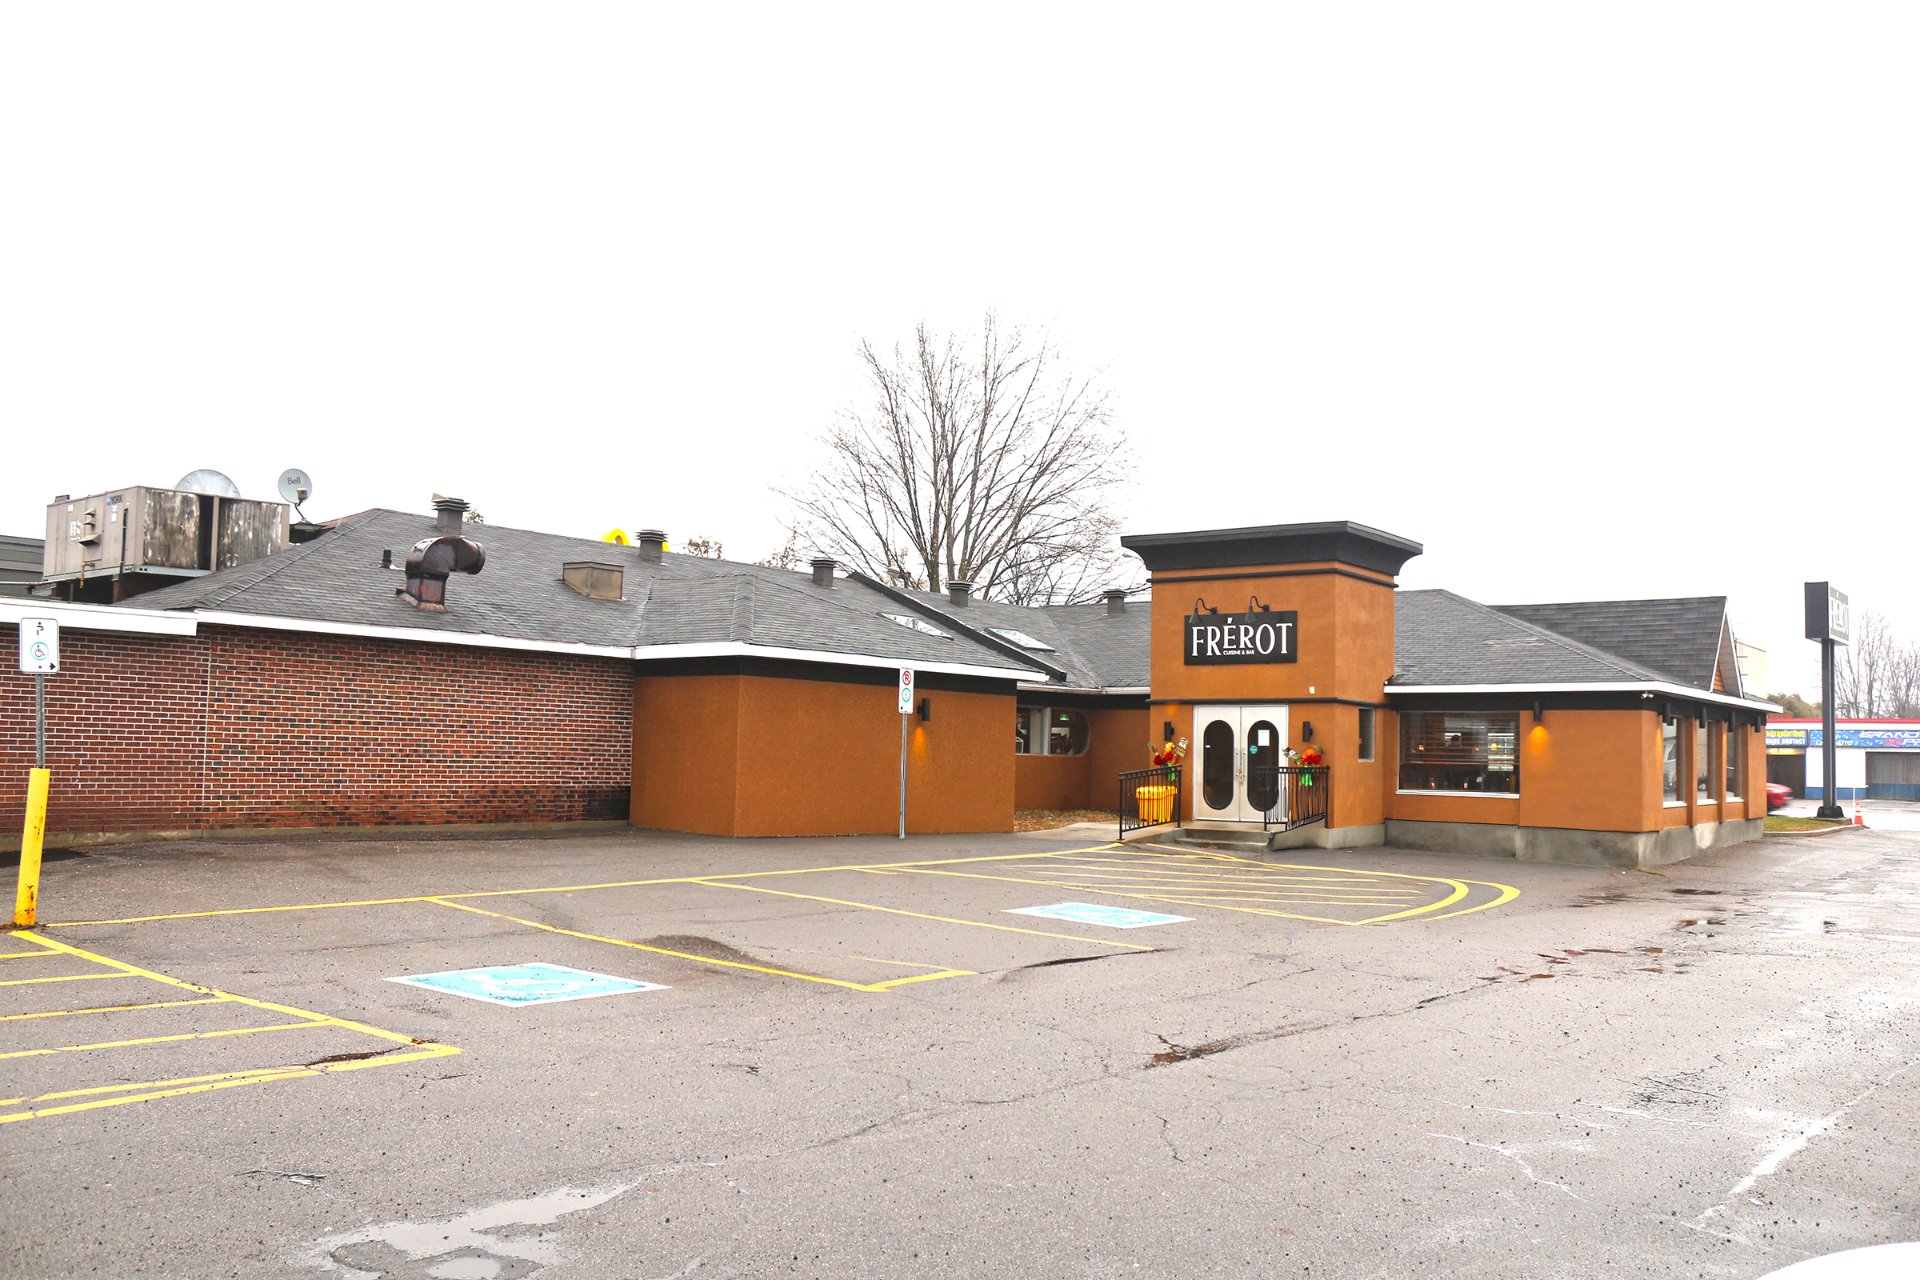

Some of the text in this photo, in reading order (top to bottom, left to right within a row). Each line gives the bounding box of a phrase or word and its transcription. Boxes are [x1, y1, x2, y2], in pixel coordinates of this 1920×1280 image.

[287, 476, 301, 485] Bell
[1192, 617, 1292, 656] FRÉROT
[1859, 731, 1920, 739] GRAND
